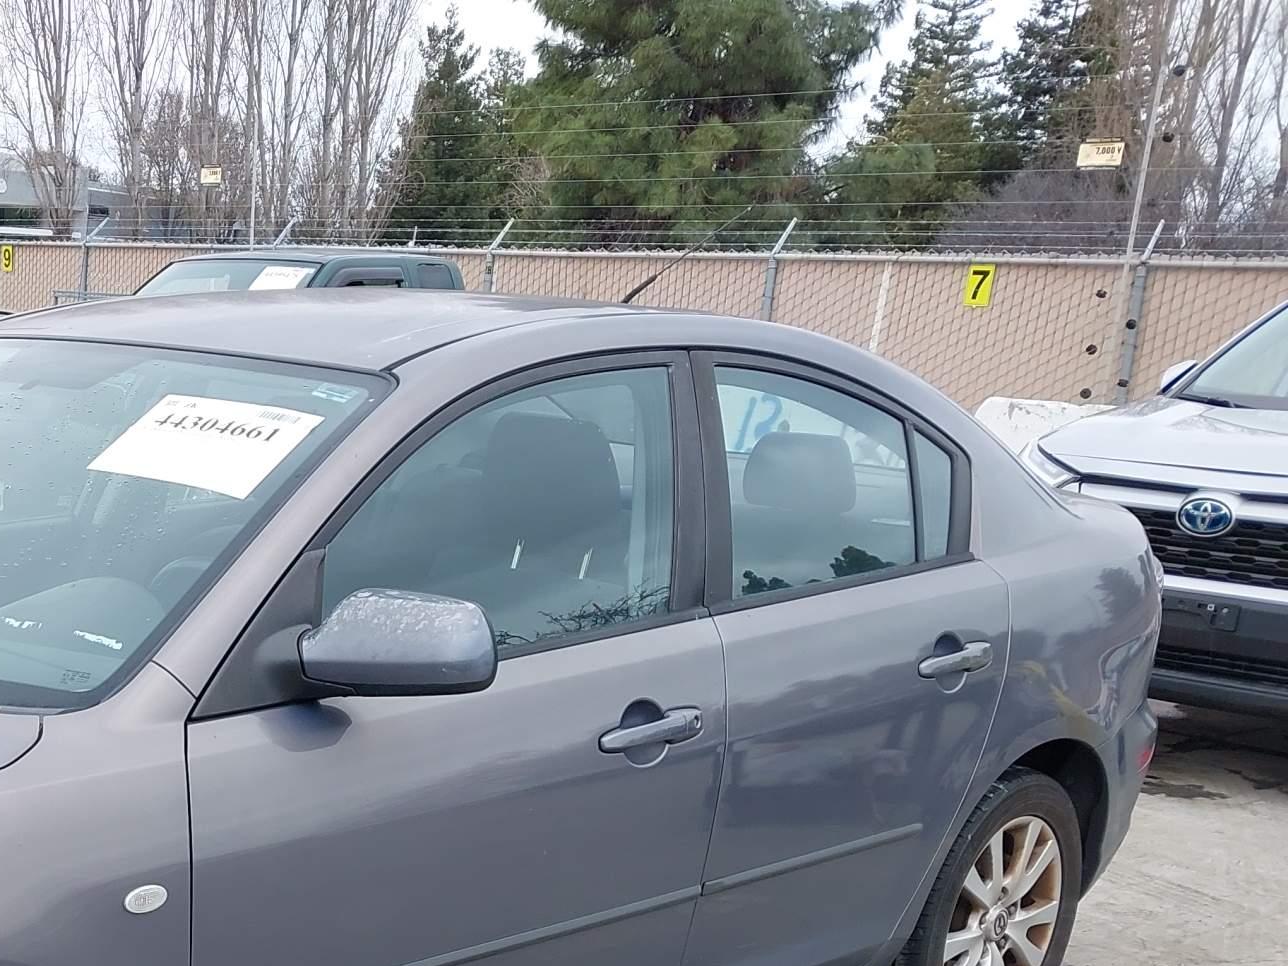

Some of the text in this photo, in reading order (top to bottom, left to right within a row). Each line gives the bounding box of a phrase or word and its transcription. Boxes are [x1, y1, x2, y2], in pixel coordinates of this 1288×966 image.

[3, 248, 11, 268] 9
[971, 269, 991, 300] 7
[154, 412, 280, 442] 44304661
